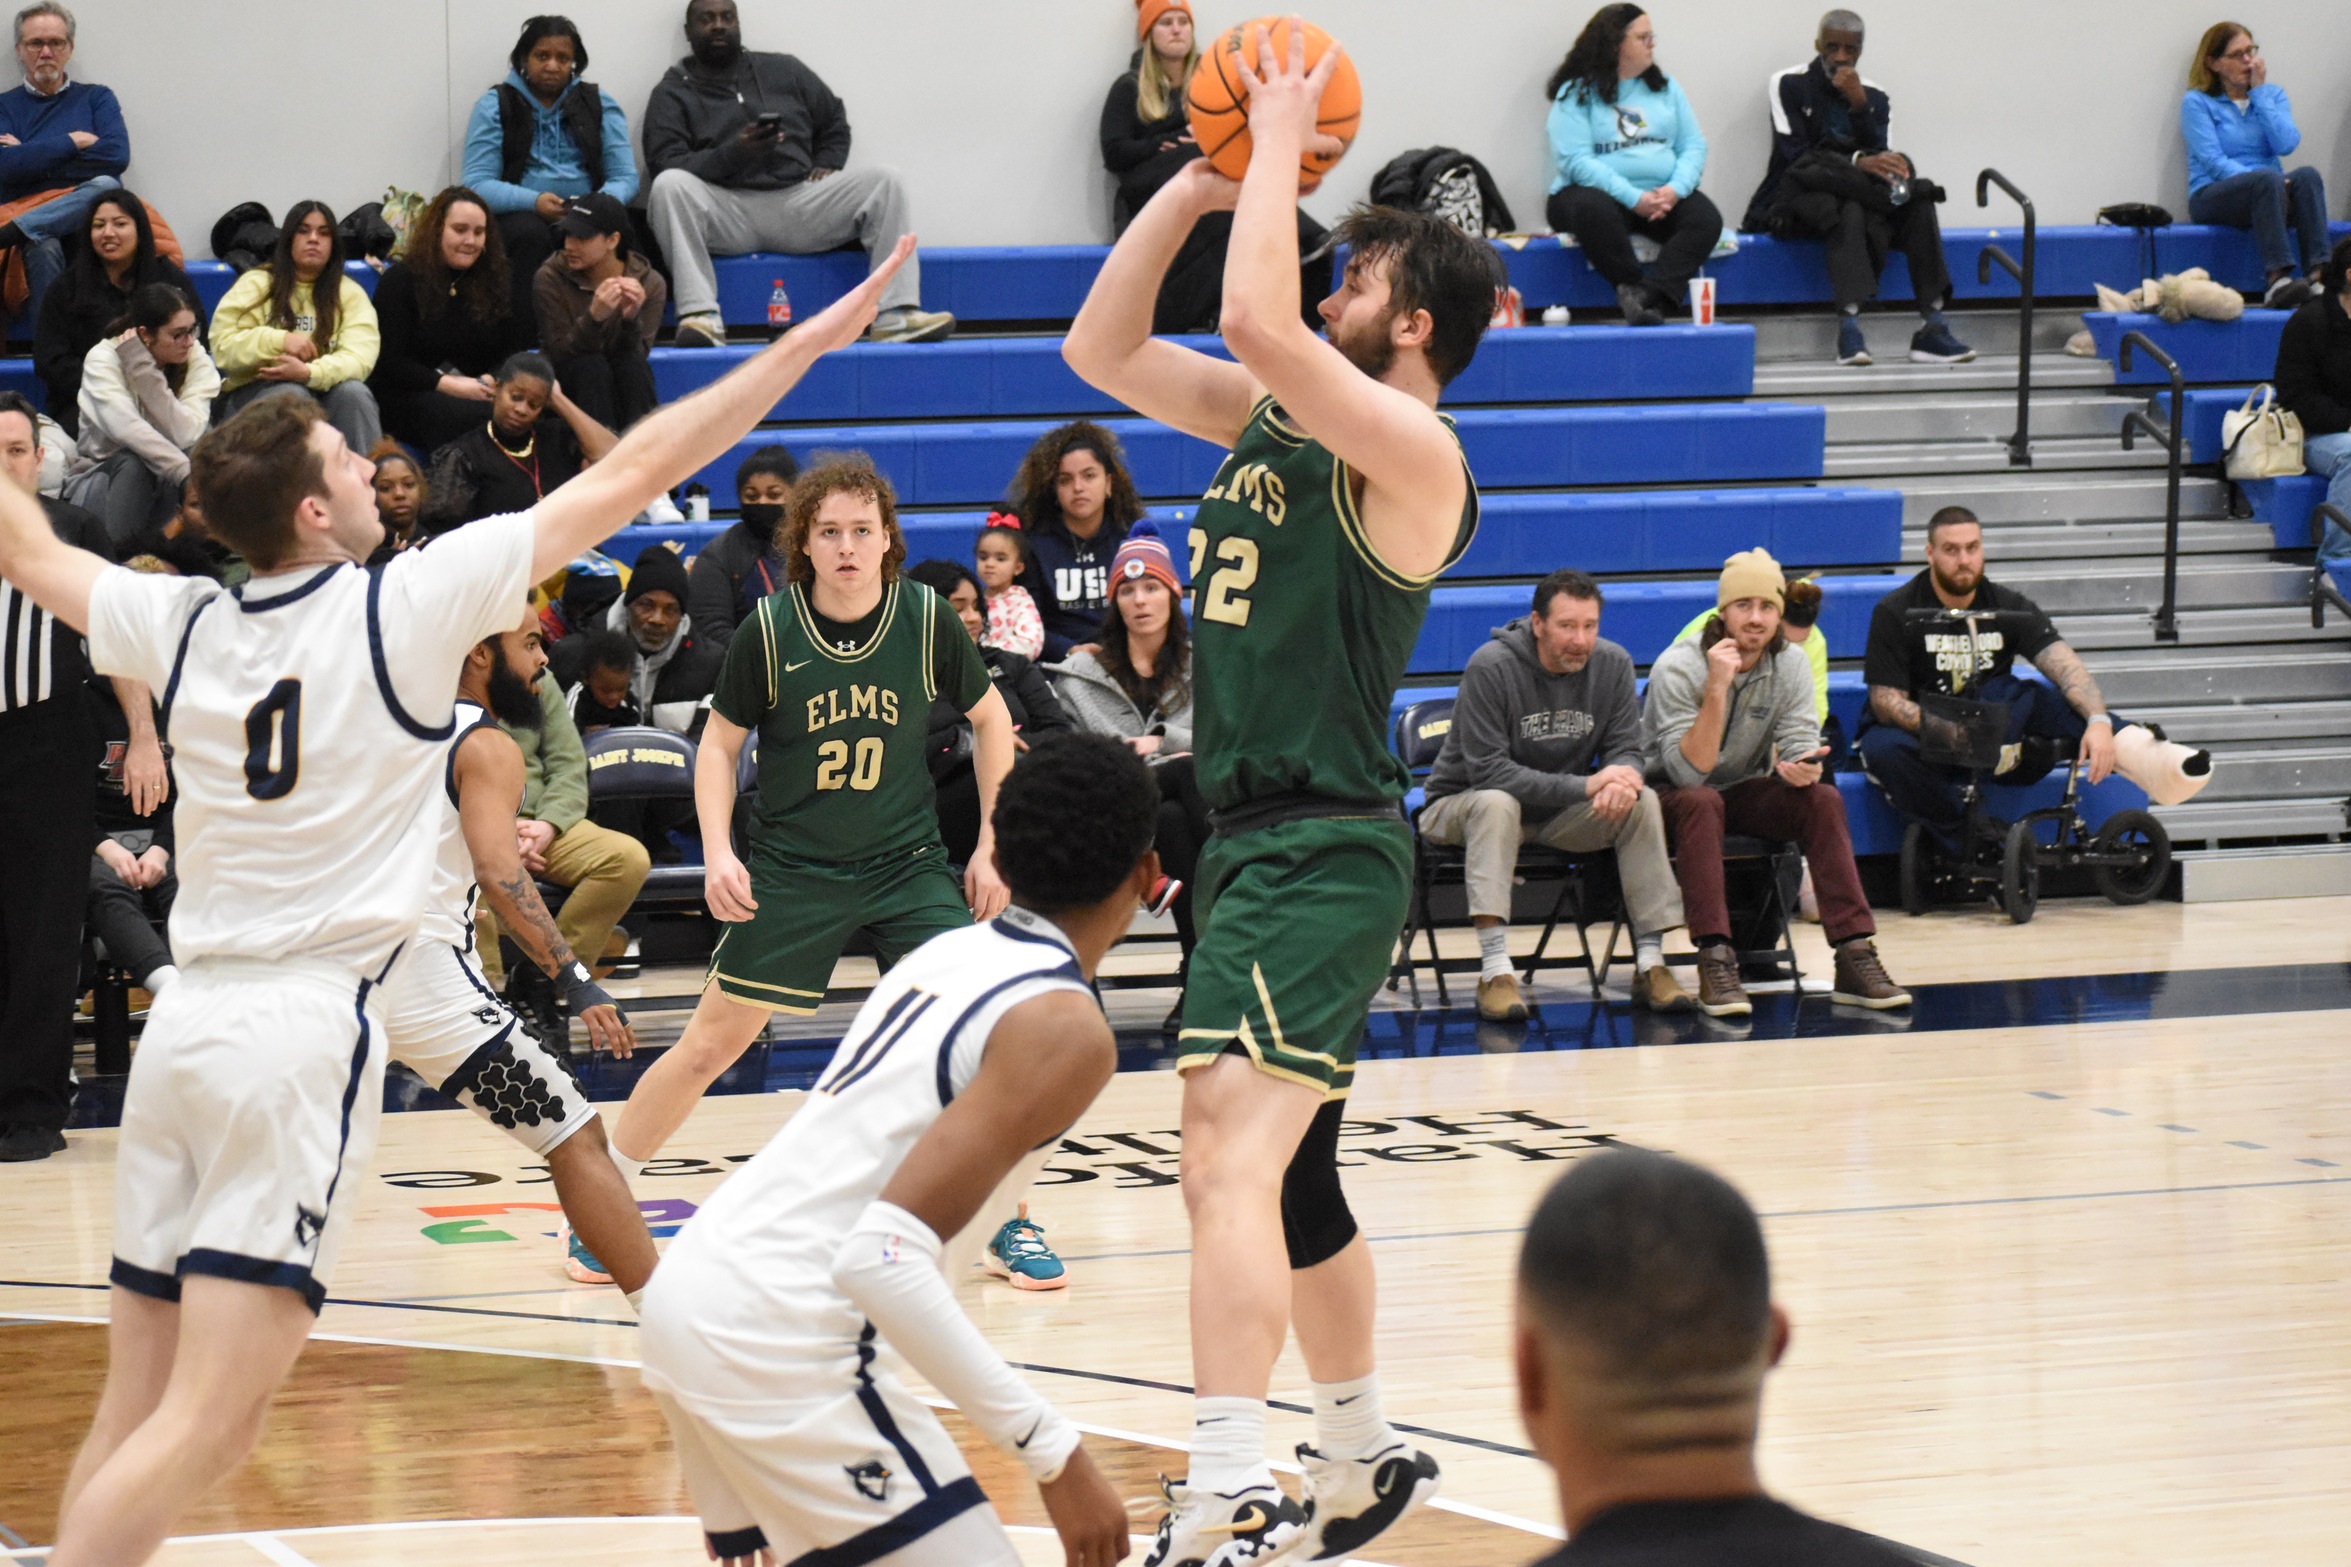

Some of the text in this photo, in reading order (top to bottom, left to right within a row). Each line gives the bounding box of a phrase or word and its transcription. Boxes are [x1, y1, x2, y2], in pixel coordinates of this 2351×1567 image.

[1202, 453, 1287, 527] LMS
[1054, 565, 1108, 601] US
[1924, 631, 2004, 652] WEATHERORD
[806, 683, 899, 733] ELMS
[1418, 719, 1452, 740] SAIN
[242, 677, 303, 801] 0
[631, 747, 686, 768] JOSEPH
[816, 736, 885, 791] 20
[820, 985, 943, 1098] 11
